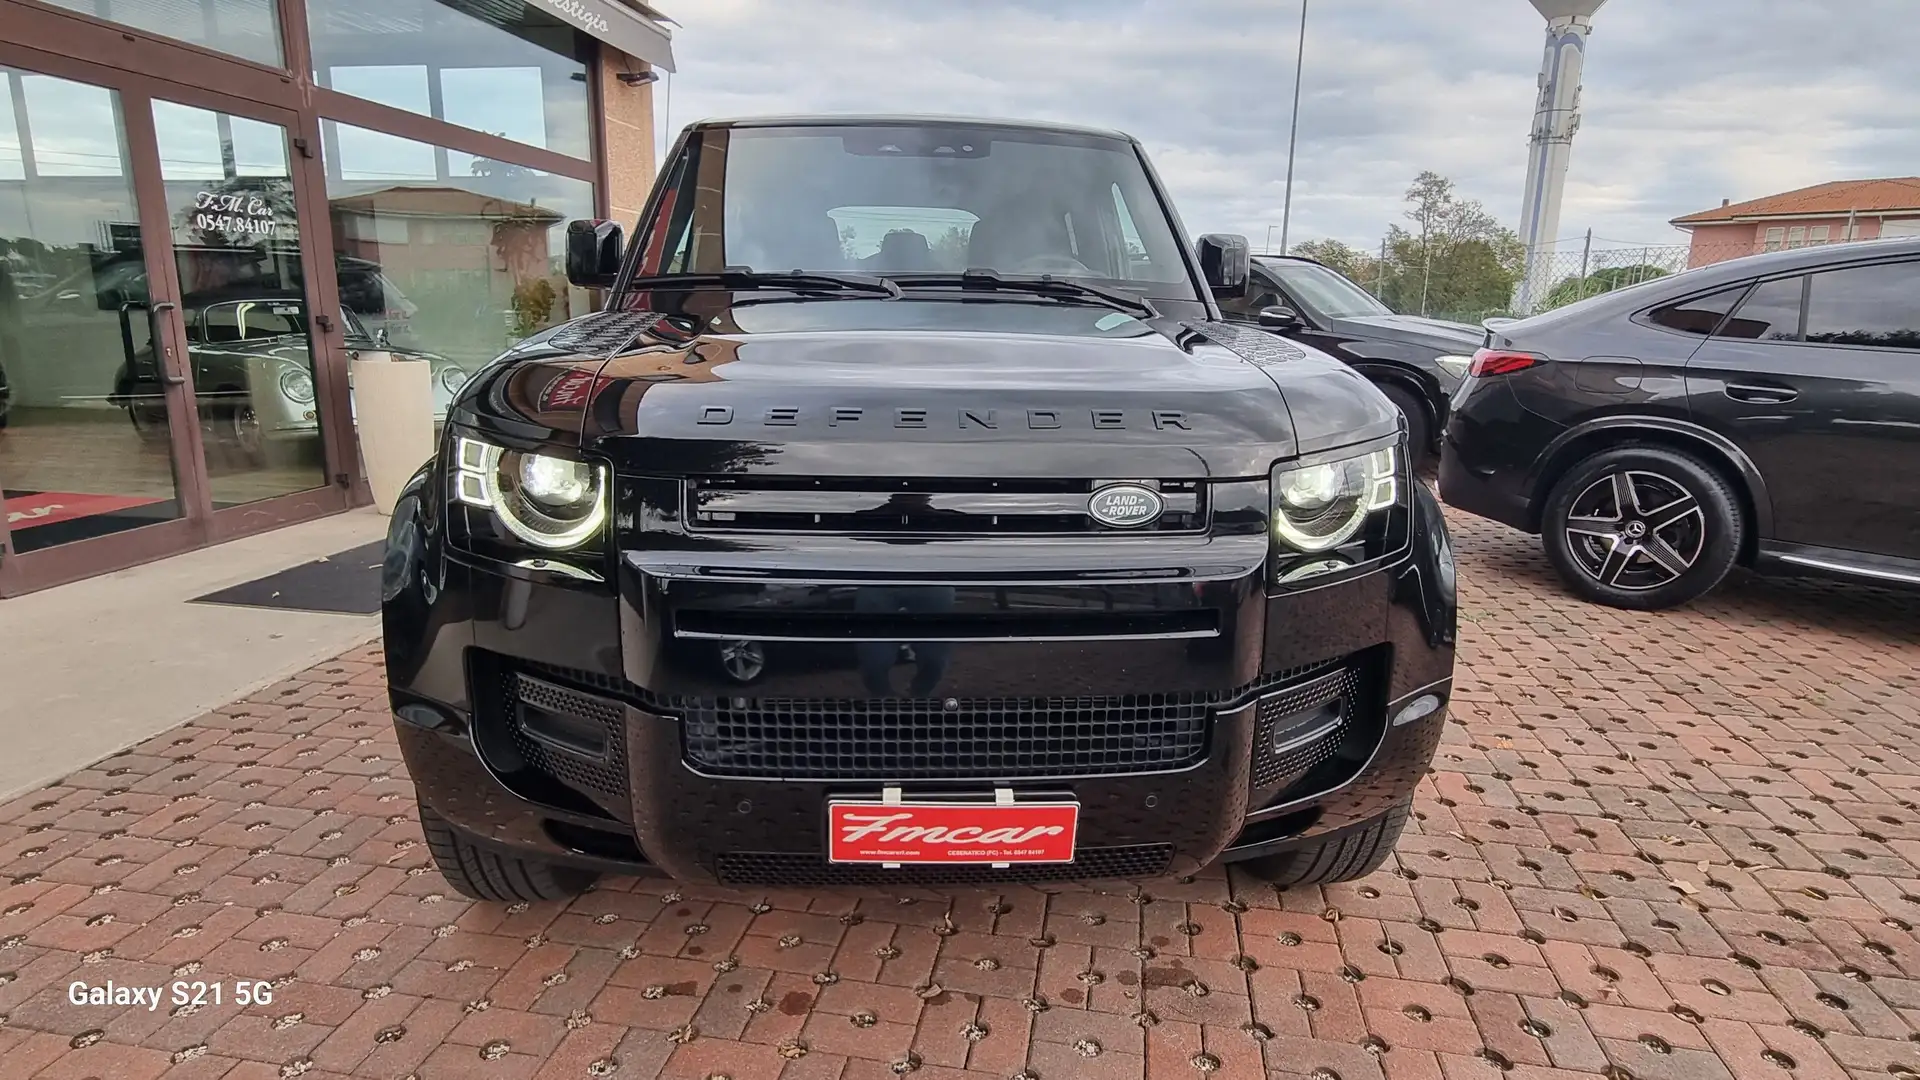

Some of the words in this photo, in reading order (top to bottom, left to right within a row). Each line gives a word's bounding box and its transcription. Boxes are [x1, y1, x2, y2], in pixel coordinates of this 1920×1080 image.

[548, 0, 609, 32] estigio
[247, 196, 274, 216] Car
[197, 213, 276, 235] 0547.84107
[696, 405, 1192, 430] DEFENDER
[1105, 495, 1138, 506] LAND
[1108, 505, 1147, 516] ROVER
[841, 813, 1064, 844] Fmcar
[947, 849, 986, 857] CESENATICO
[986, 849, 999, 857] (FC)
[1028, 848, 1045, 856] 84107
